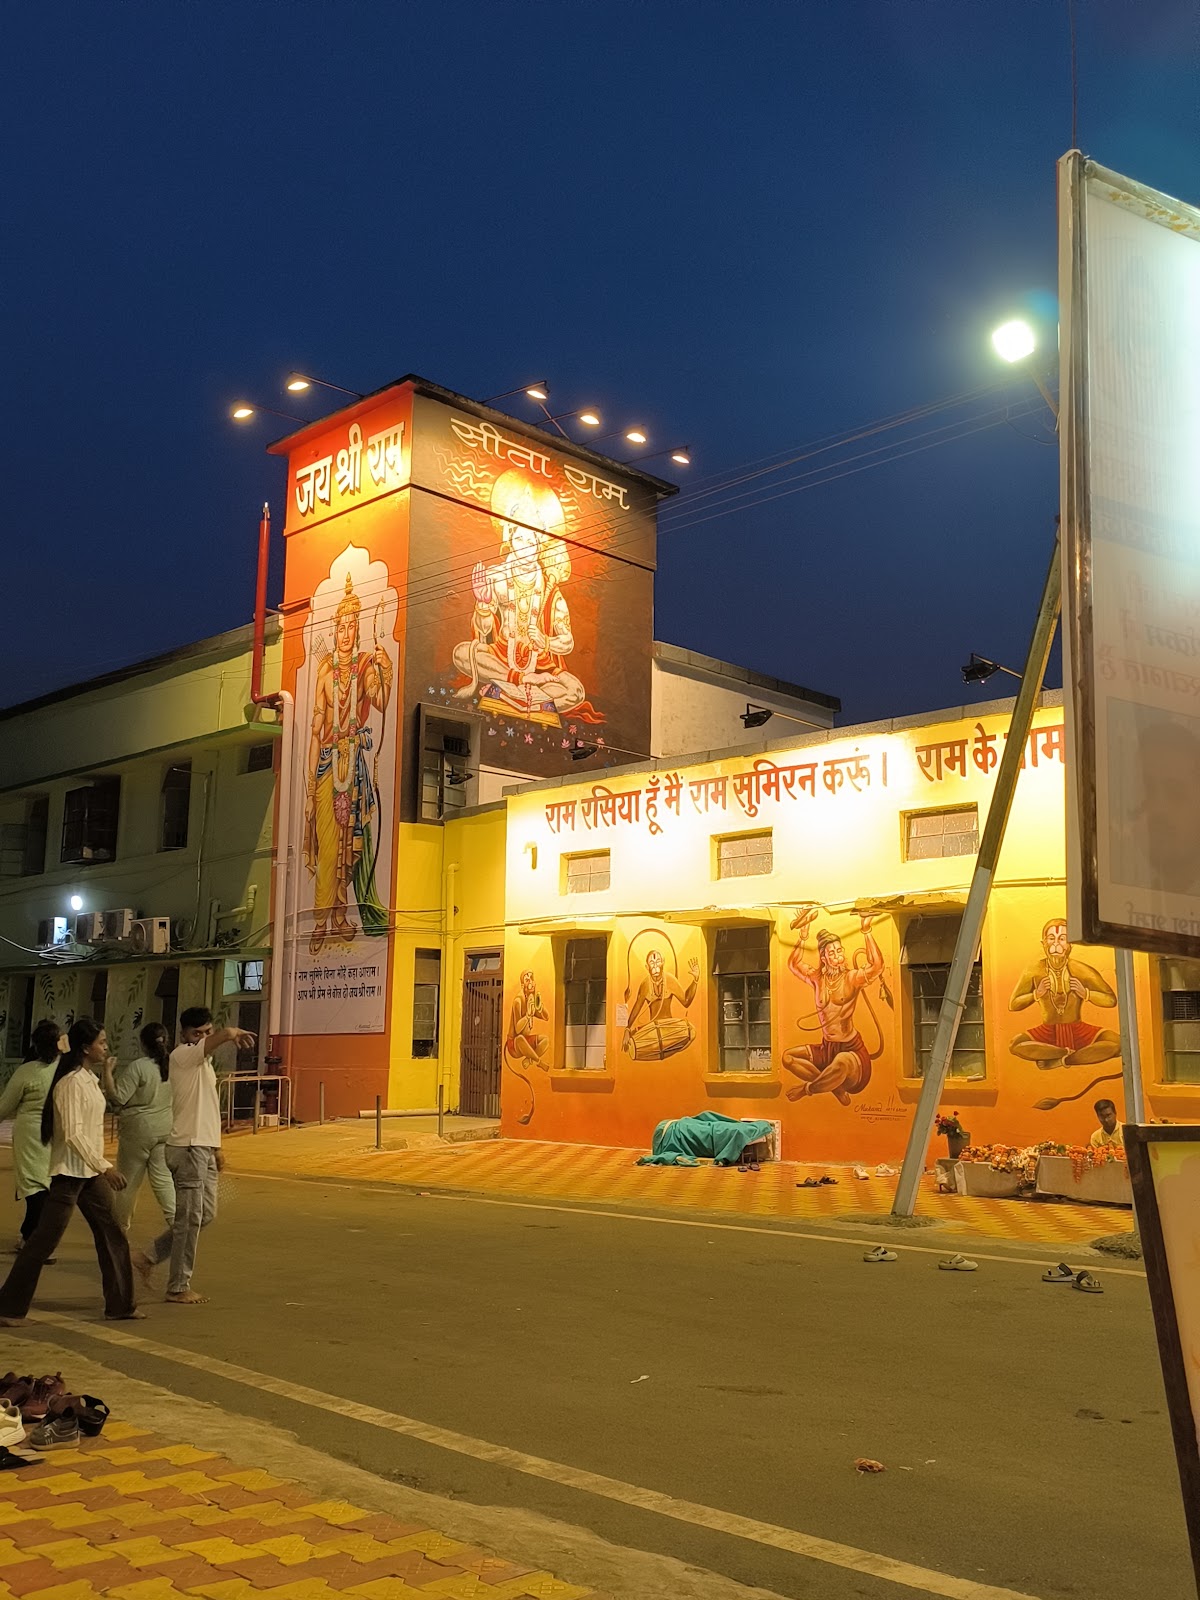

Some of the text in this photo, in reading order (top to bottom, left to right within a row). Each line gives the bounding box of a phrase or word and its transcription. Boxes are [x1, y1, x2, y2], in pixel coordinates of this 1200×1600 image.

[296, 421, 405, 516] जय श्री राम
[451, 418, 630, 510] सीता राम
[916, 723, 1065, 782] राम के ाम
[546, 800, 577, 834] राम
[581, 785, 641, 830] रसिया
[646, 775, 663, 835] हूँ
[664, 772, 683, 816] मैं
[689, 776, 728, 814] राम
[733, 759, 818, 818] सुमिरन
[298, 990, 308, 1000] आप
[309, 986, 316, 999] भी
[317, 986, 325, 999] प्रेम
[327, 985, 331, 998] से
[343, 984, 348, 998] दो
[366, 986, 376, 997] राम
[299, 972, 307, 981] नाम
[359, 967, 376, 977] आराम
